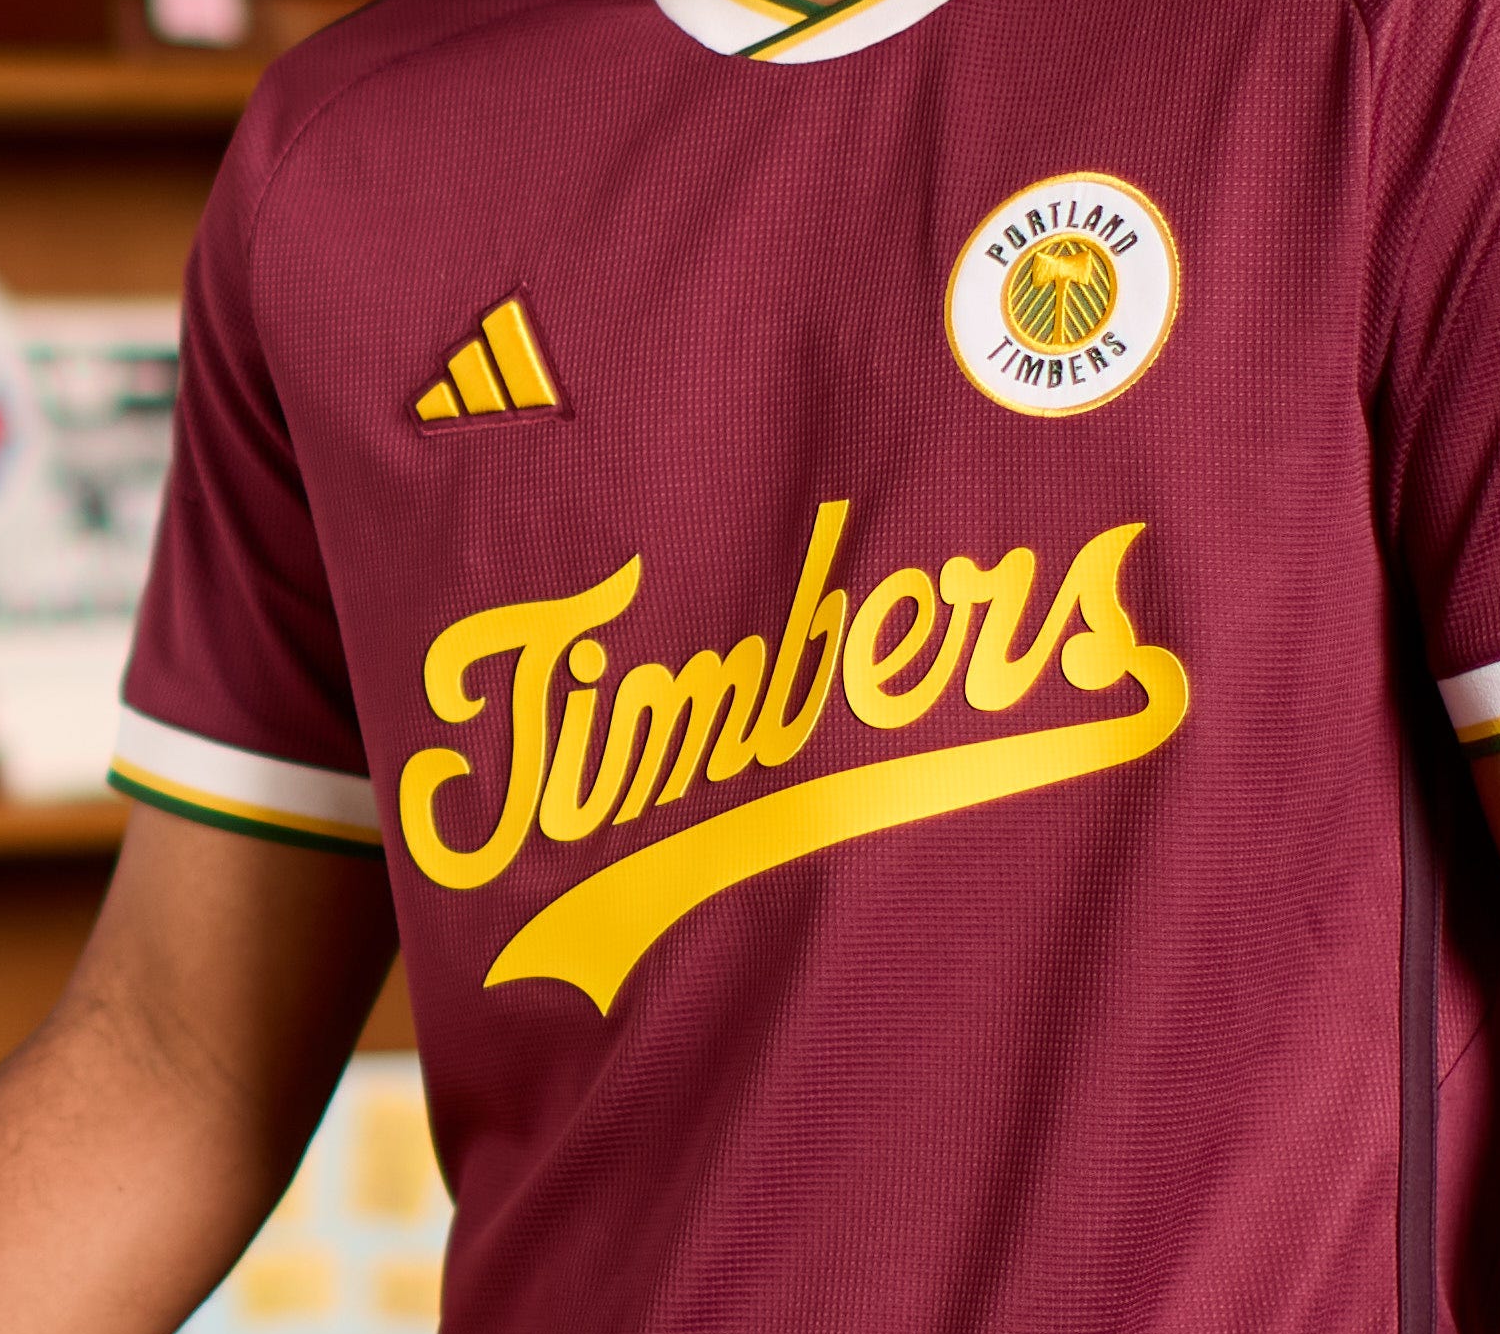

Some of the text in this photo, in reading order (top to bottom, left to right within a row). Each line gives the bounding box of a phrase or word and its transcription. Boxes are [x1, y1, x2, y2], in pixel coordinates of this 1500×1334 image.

[985, 200, 1139, 267] PORTLAND
[987, 331, 1128, 389] TIMBERS
[400, 499, 1158, 889] Timbers
